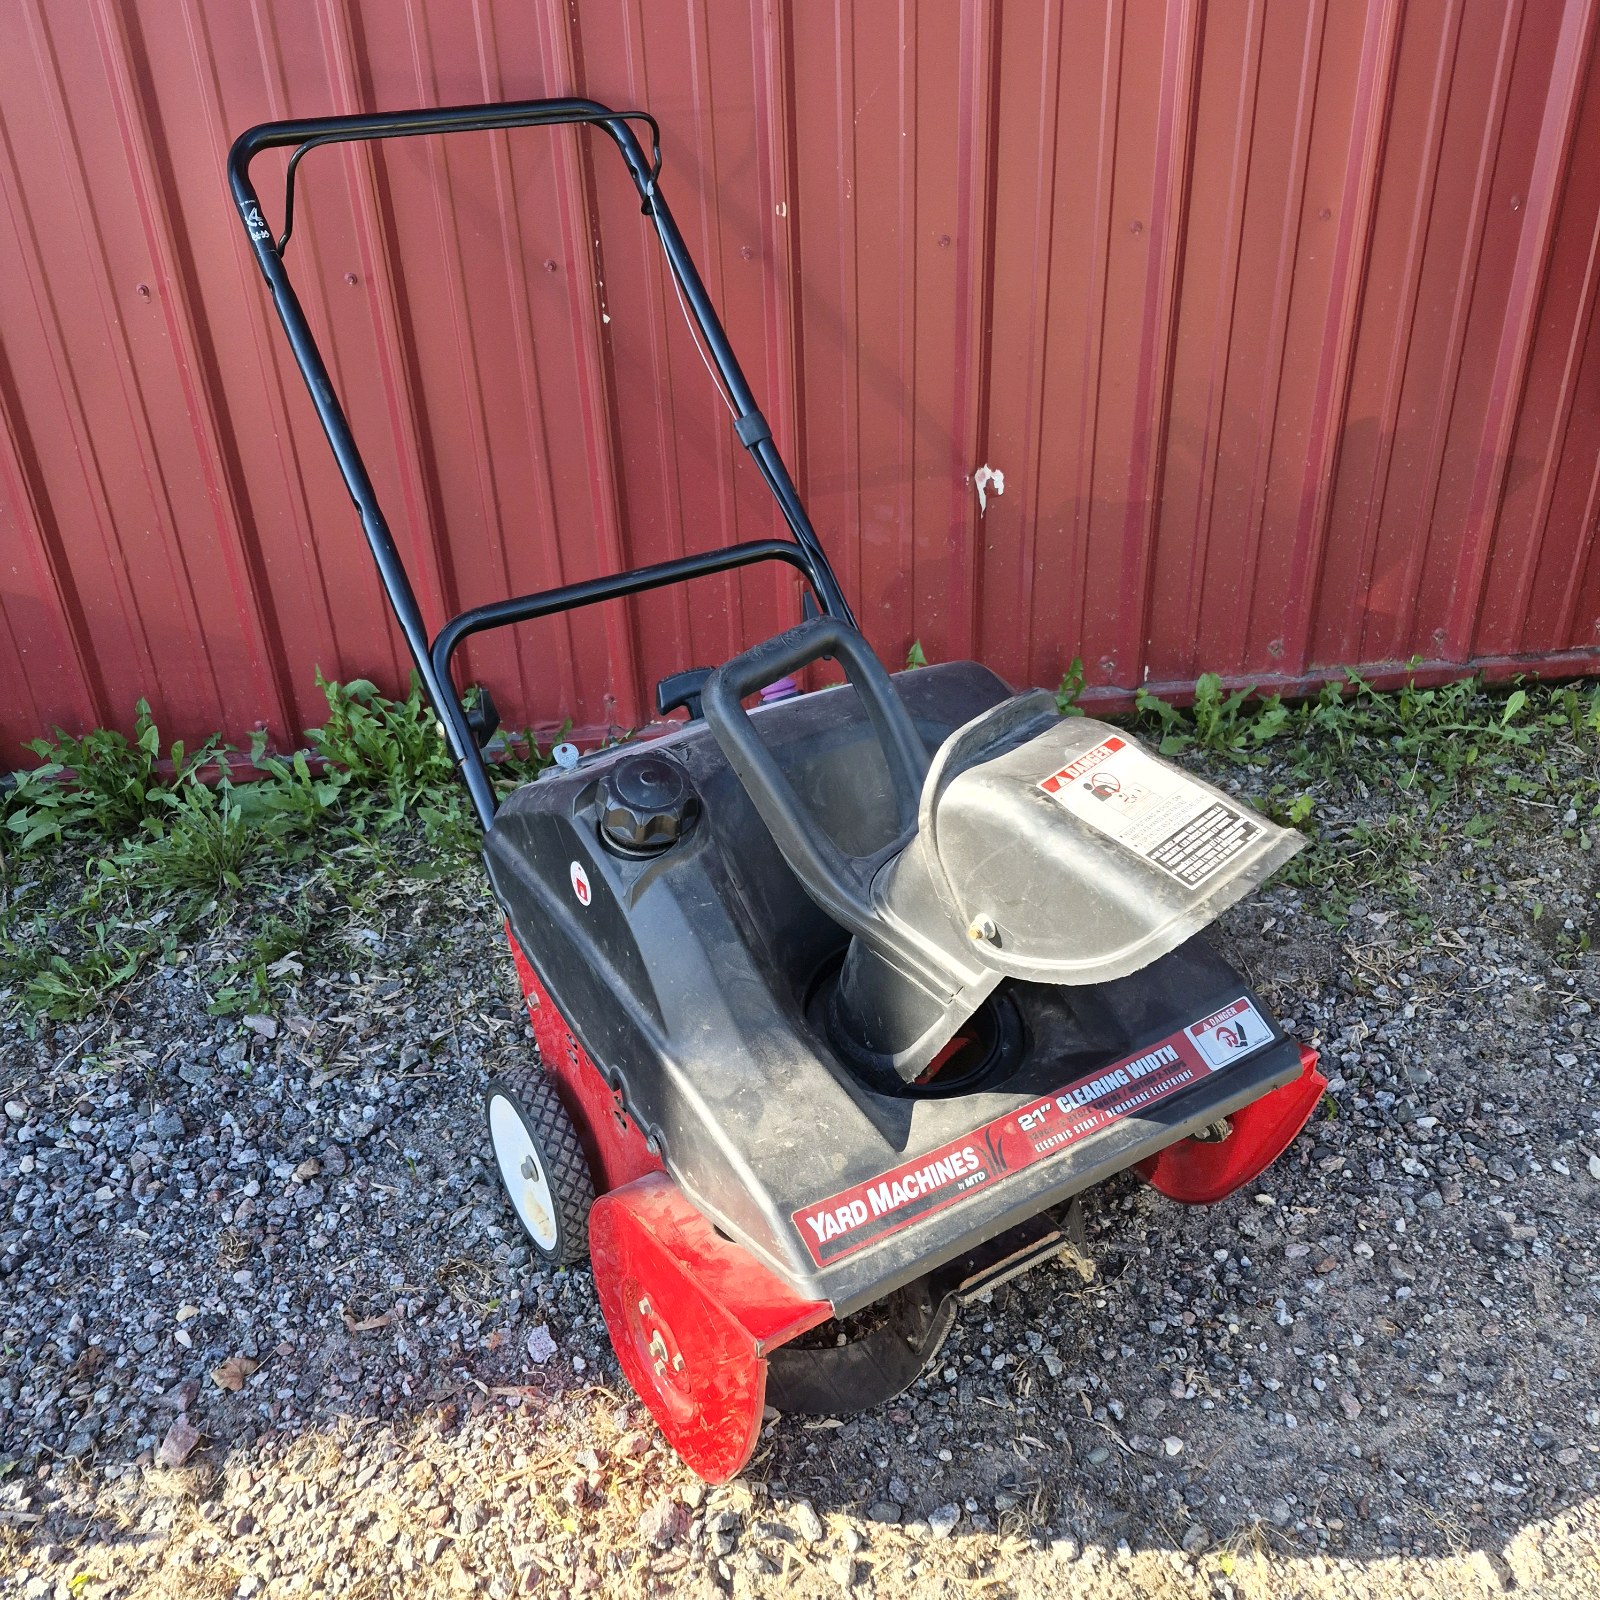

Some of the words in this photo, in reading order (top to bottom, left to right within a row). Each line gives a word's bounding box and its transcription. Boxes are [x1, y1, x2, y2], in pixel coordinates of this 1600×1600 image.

[1066, 745, 1115, 777] DANGER
[1208, 1006, 1238, 1027] DANGER
[1055, 1068, 1131, 1114] CLEARING
[1124, 1044, 1180, 1080] WIDTH
[1034, 1129, 1074, 1153] ELECTRIC
[1073, 1116, 1099, 1134] START
[1100, 1112, 1105, 1122] /
[1105, 1090, 1151, 1119] DÉMARRAGE
[1149, 1069, 1194, 1096] ÉLECTRIQUE
[806, 1199, 869, 1243] YARD
[866, 1146, 980, 1217] MACHINES
[964, 1171, 986, 1188] MTD
